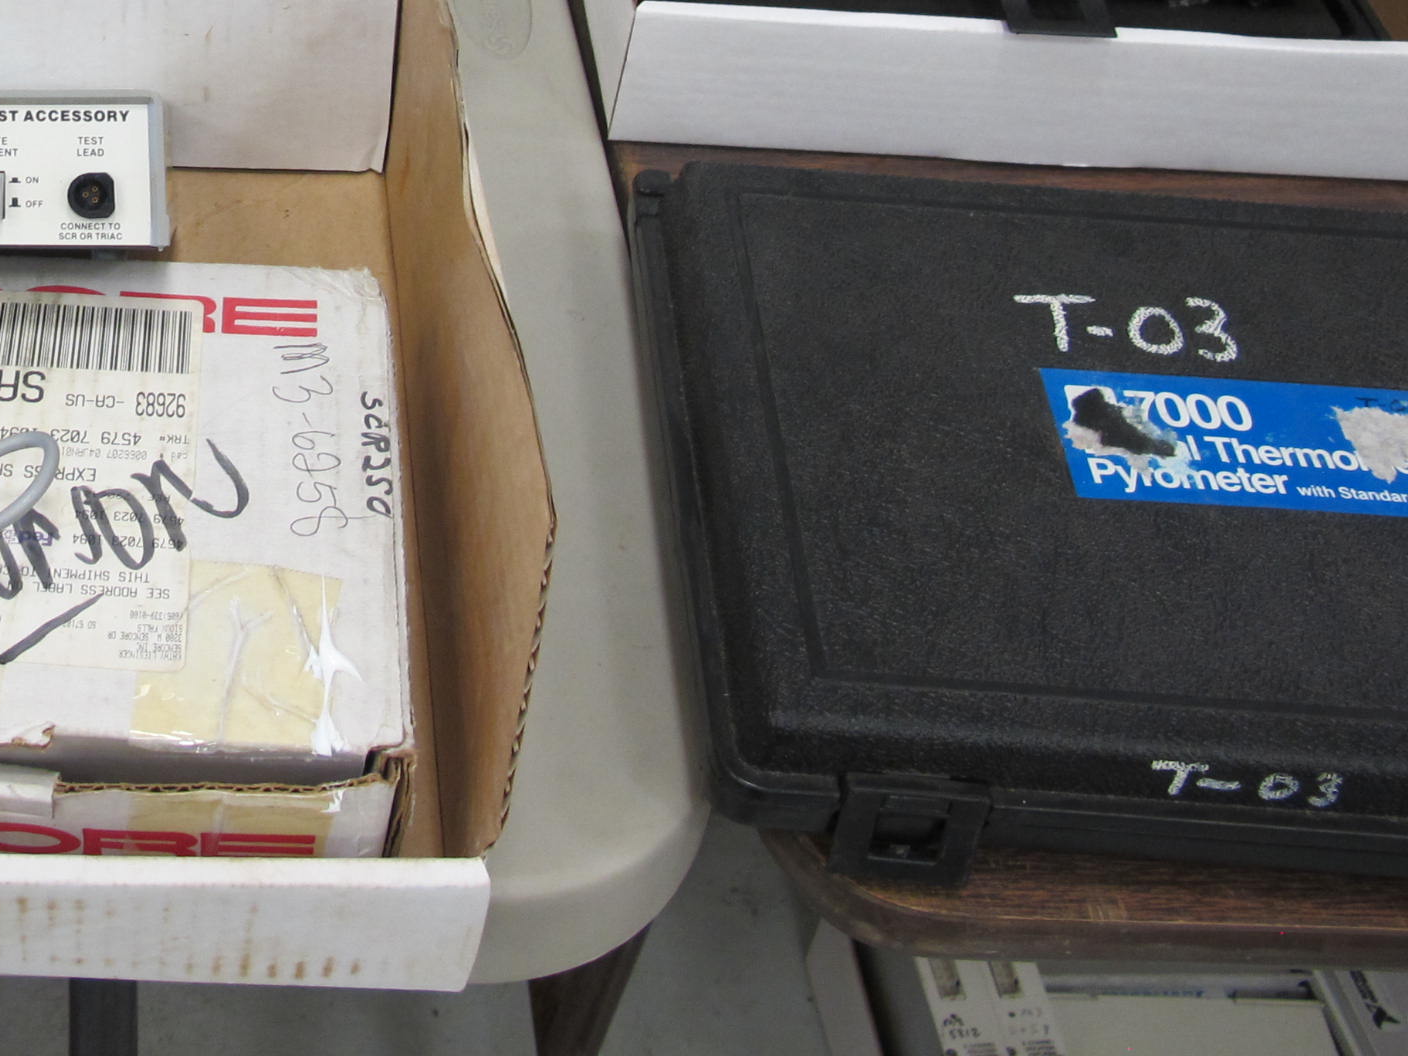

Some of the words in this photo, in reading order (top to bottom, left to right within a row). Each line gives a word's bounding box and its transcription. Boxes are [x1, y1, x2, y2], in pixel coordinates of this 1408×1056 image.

[24, 110, 129, 122] ACCESSORY
[78, 136, 104, 144] TEST
[76, 148, 105, 157] LEAD
[25, 176, 40, 184] ON
[25, 200, 43, 208] OFF
[1013, 293, 1238, 362] T-03
[65, 394, 125, 408] -CA-US
[135, 392, 186, 418] 92683
[50, 428, 90, 444] 7023
[100, 431, 142, 445] 4579
[360, 391, 392, 519] SCR250
[23, 464, 96, 482] EXPRSS
[1087, 458, 1289, 494] Pyrometer
[1296, 485, 1337, 498] with
[119, 573, 150, 584] THIS
[80, 586, 138, 598] ADDRESS
[146, 588, 170, 599] SEE
[1151, 760, 1343, 807] T-03
